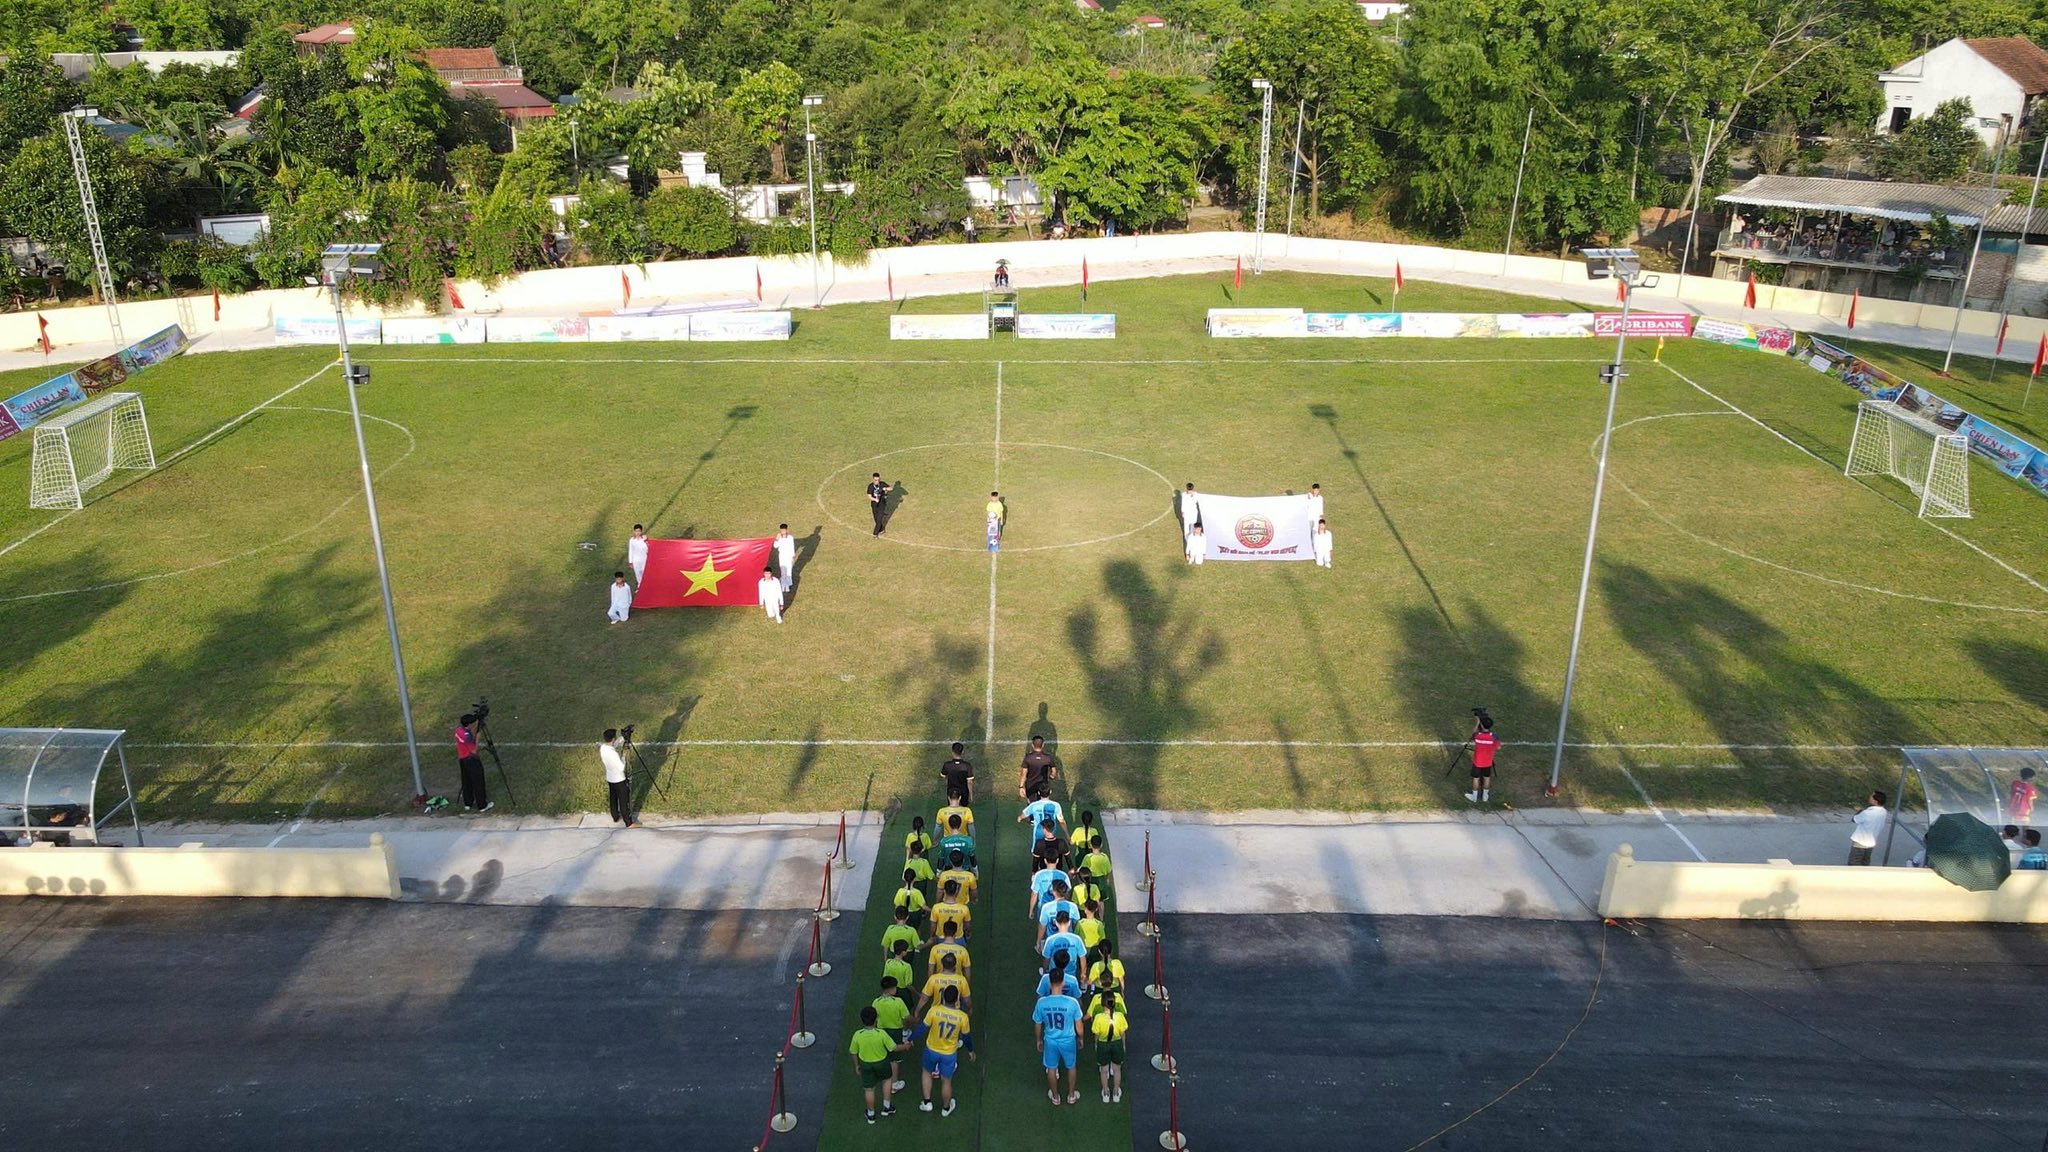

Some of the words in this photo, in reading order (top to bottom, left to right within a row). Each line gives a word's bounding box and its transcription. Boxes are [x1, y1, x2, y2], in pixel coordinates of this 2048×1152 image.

[1999, 445, 2020, 460] LAN
[1046, 1012, 1065, 1030] 18
[938, 1021, 957, 1040] 17
